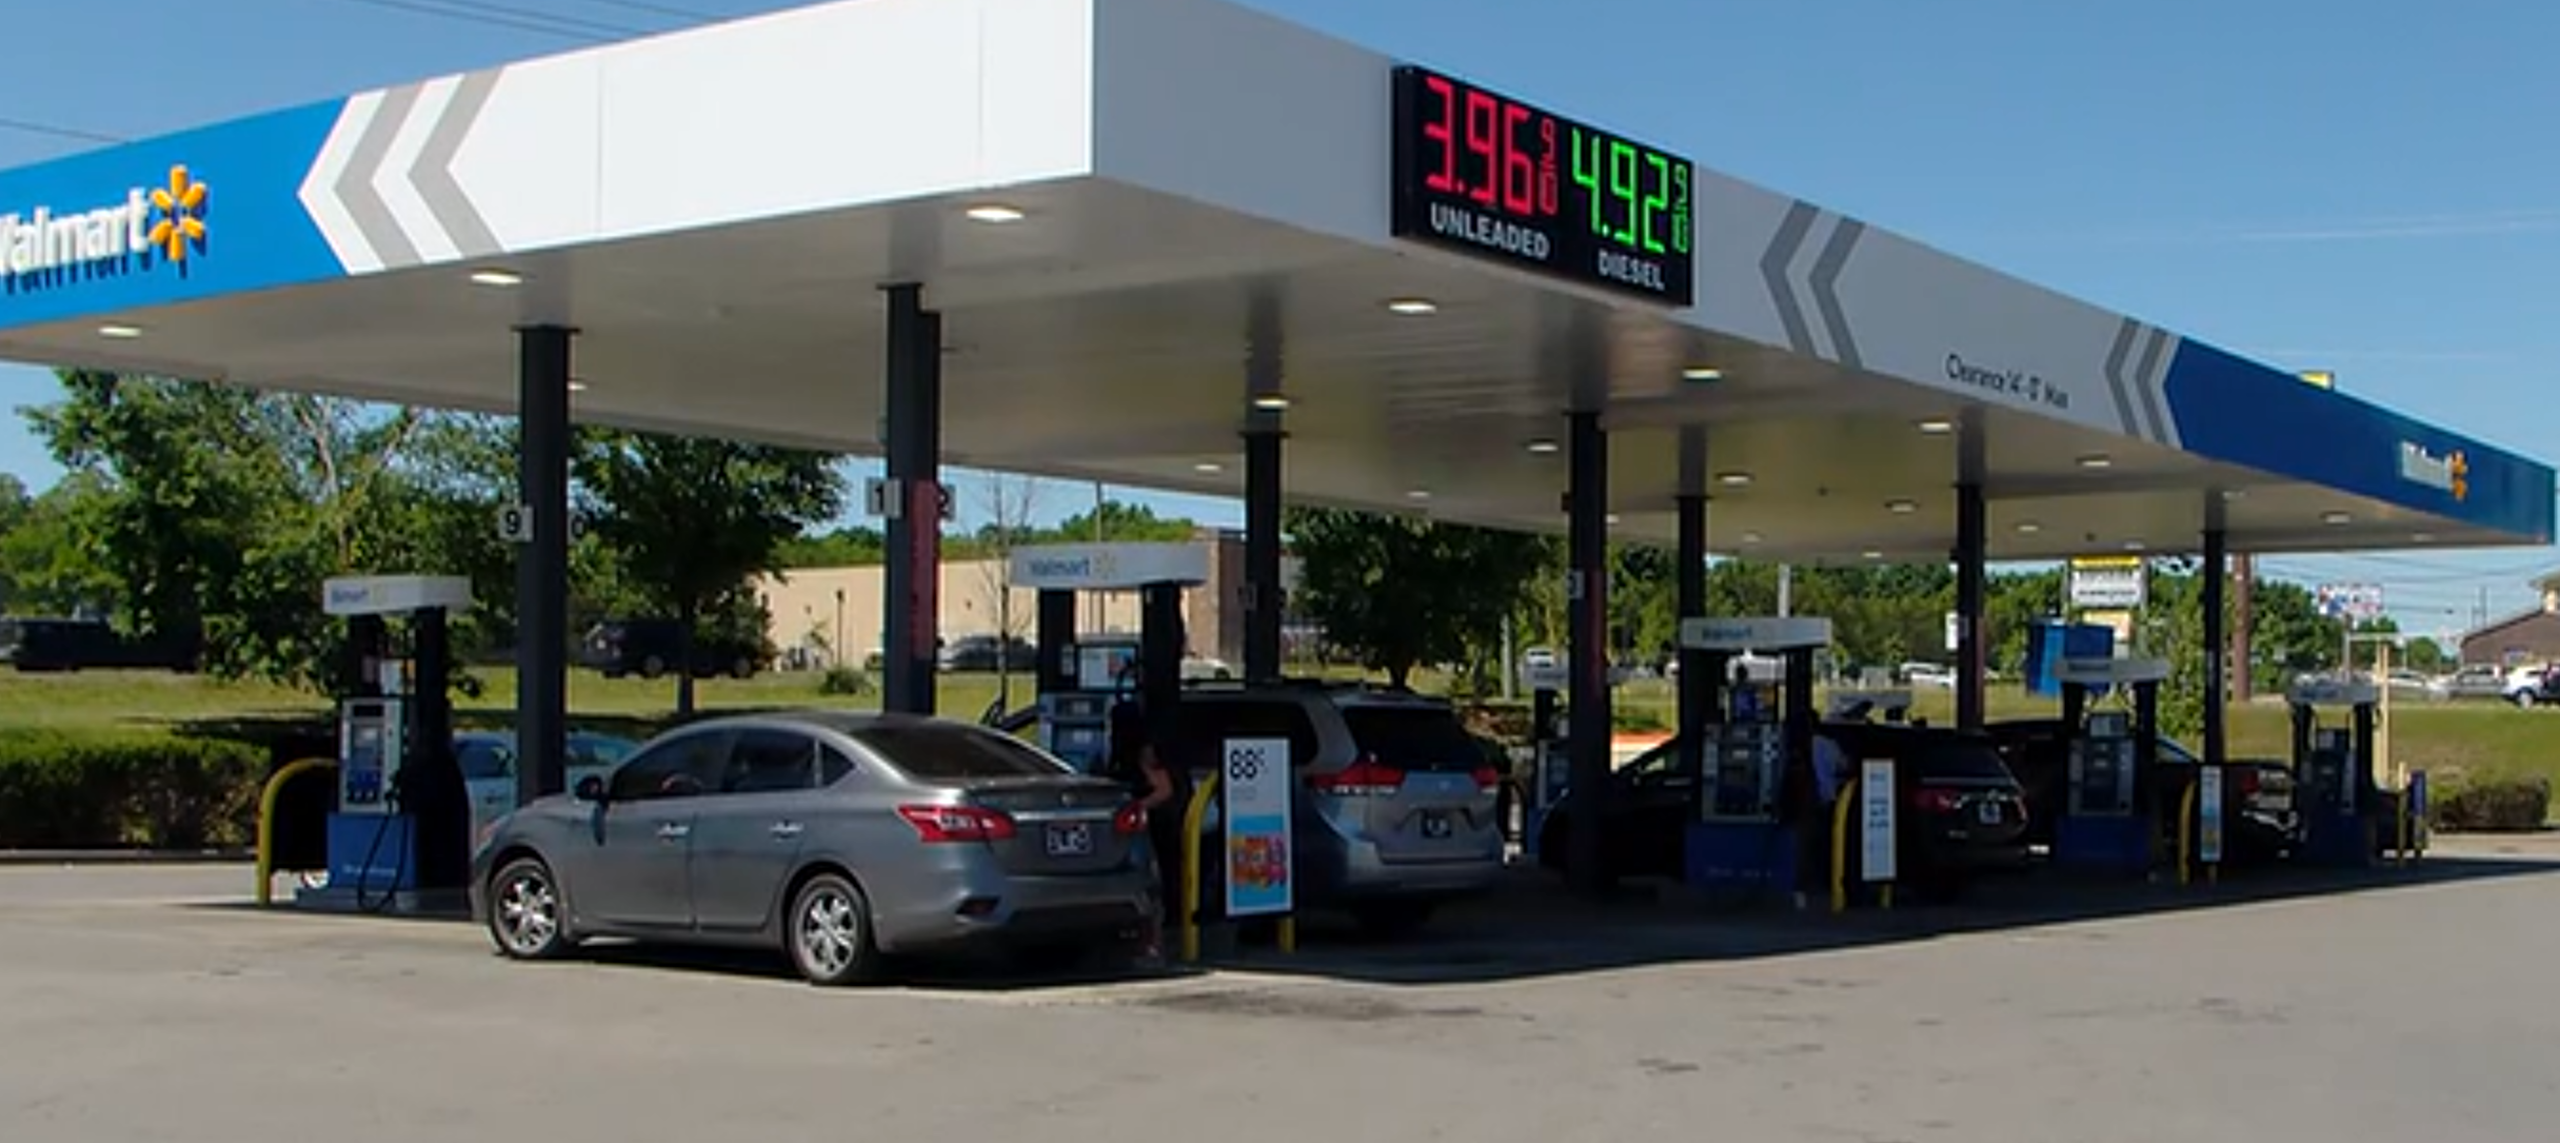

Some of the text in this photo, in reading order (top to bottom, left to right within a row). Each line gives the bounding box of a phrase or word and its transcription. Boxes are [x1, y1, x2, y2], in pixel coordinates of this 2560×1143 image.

[1430, 202, 1550, 258] UNLEADED
[1599, 250, 1666, 290] DIESEL
[505, 510, 522, 536] 9
